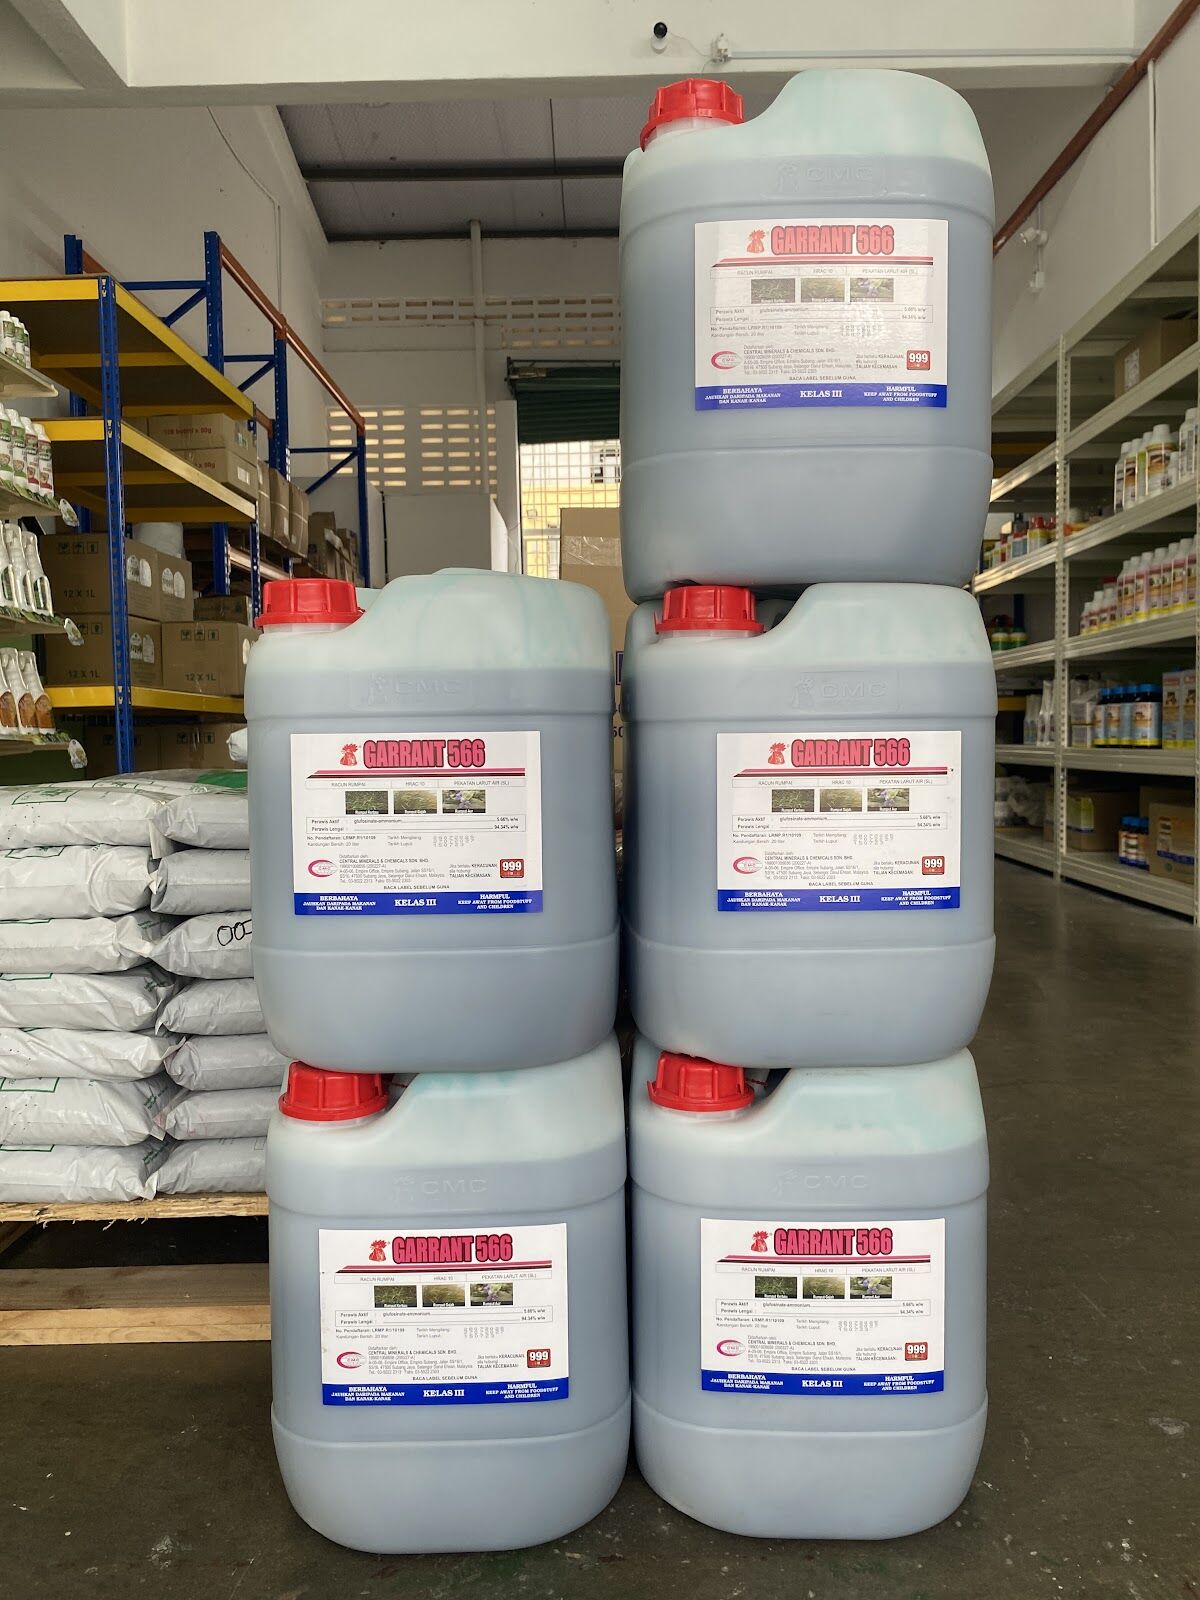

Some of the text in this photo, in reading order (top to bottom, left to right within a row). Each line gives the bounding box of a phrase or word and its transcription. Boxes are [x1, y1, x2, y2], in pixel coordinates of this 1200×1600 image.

[771, 225, 894, 255] GARRANT 566
[910, 353, 928, 363] 999
[64, 589, 74, 598] 12
[85, 589, 96, 598] 1L
[90, 669, 100, 678] 1L
[185, 672, 195, 680] 12
[205, 672, 216, 681] 1L
[363, 739, 486, 768] GARRANT 566
[791, 738, 911, 767] GARRANT 566
[503, 861, 522, 871] 999
[925, 858, 943, 868] 999
[774, 1228, 893, 1256] GARRANT 566
[392, 1234, 513, 1264] GARRANT 566
[907, 1345, 926, 1354] 999
[530, 1351, 548, 1361] 999
